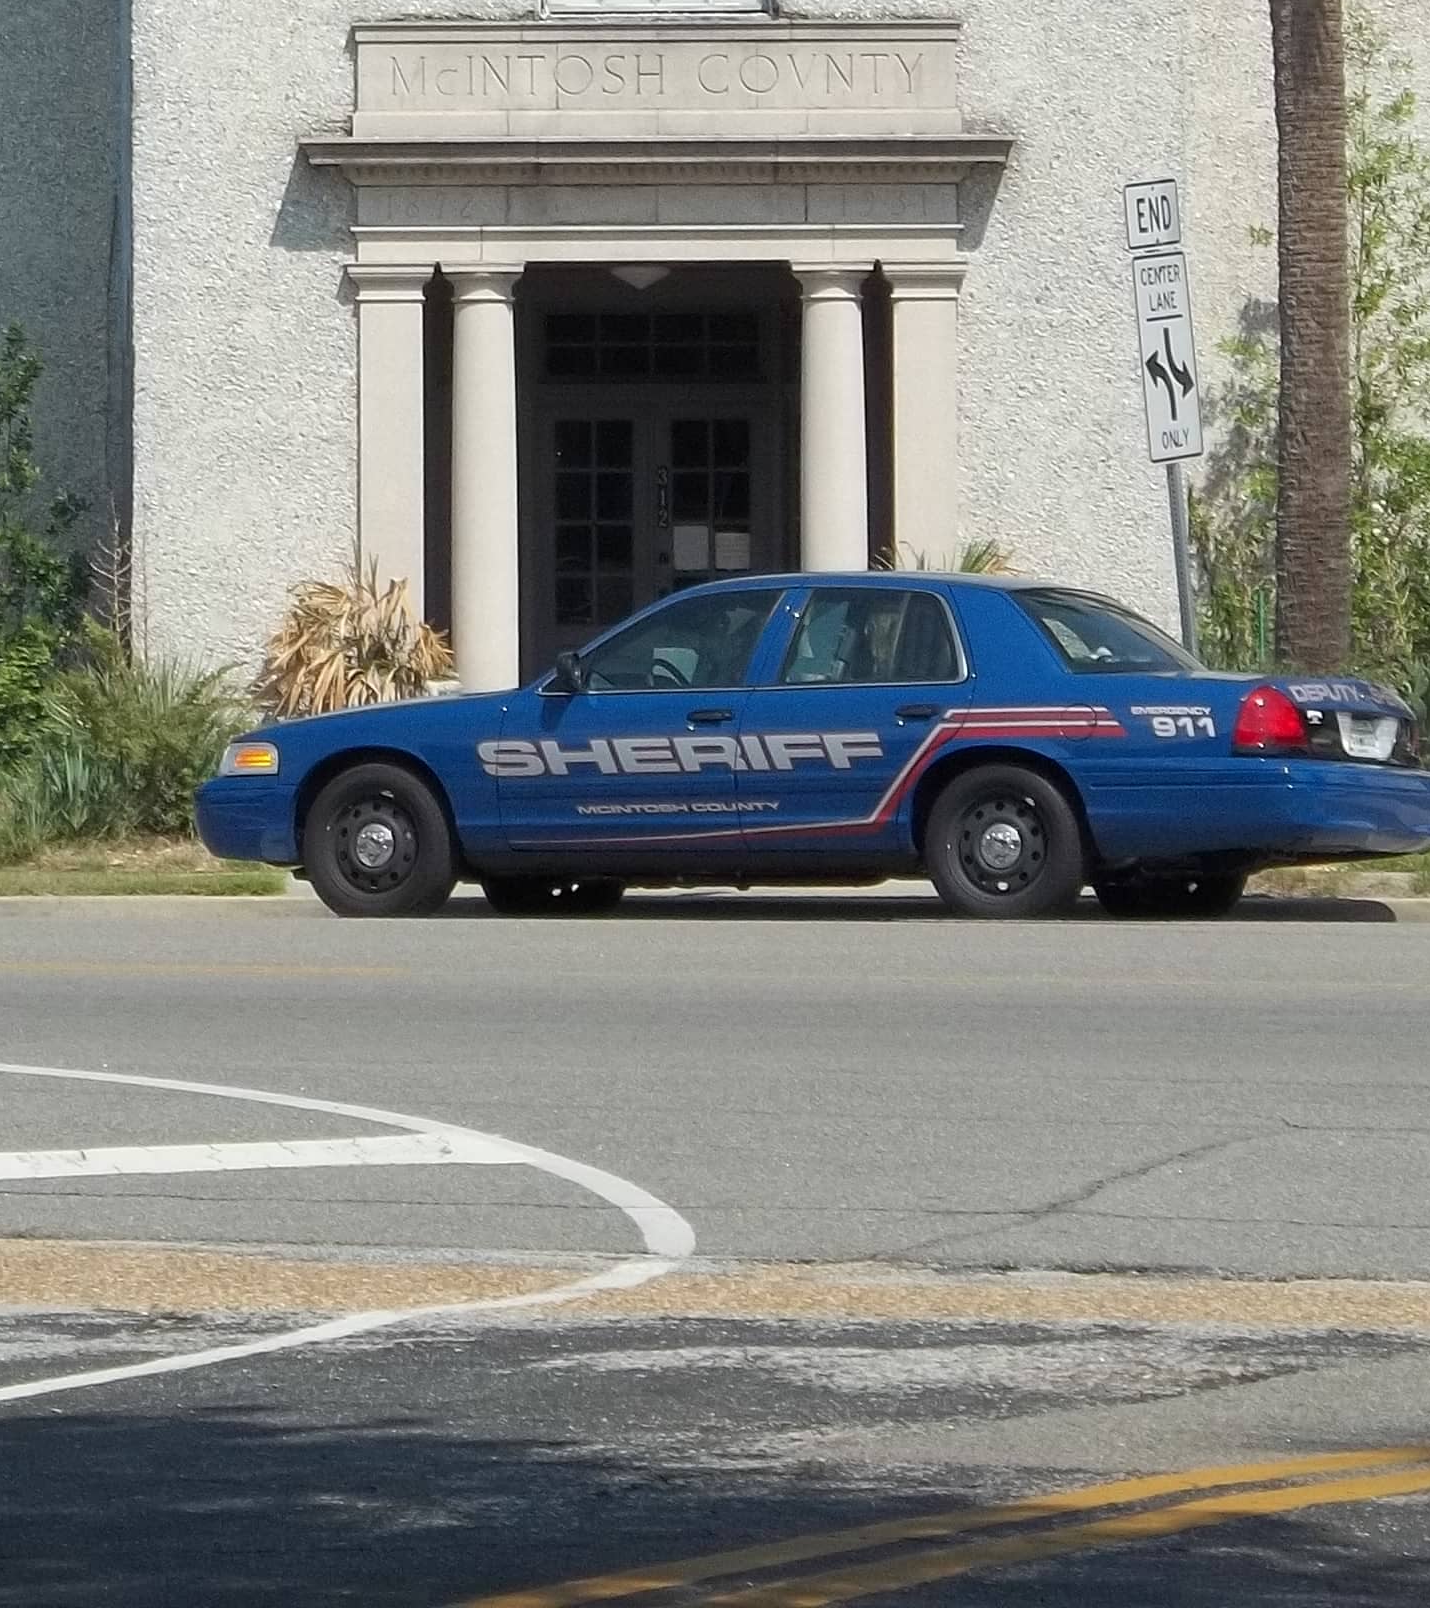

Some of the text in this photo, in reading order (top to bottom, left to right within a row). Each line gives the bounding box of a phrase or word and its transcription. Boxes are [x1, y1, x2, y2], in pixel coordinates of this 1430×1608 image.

[390, 53, 666, 95] McINTOSH
[1136, 194, 1172, 234] END
[1140, 264, 1181, 287] CENTER
[1148, 290, 1178, 312] LANE
[1161, 429, 1190, 450] ONLY
[1287, 683, 1360, 703] DEPUTY
[1152, 716, 1217, 738] 911
[477, 732, 884, 778] SHERIFF
[690, 800, 781, 812] COUNTY
